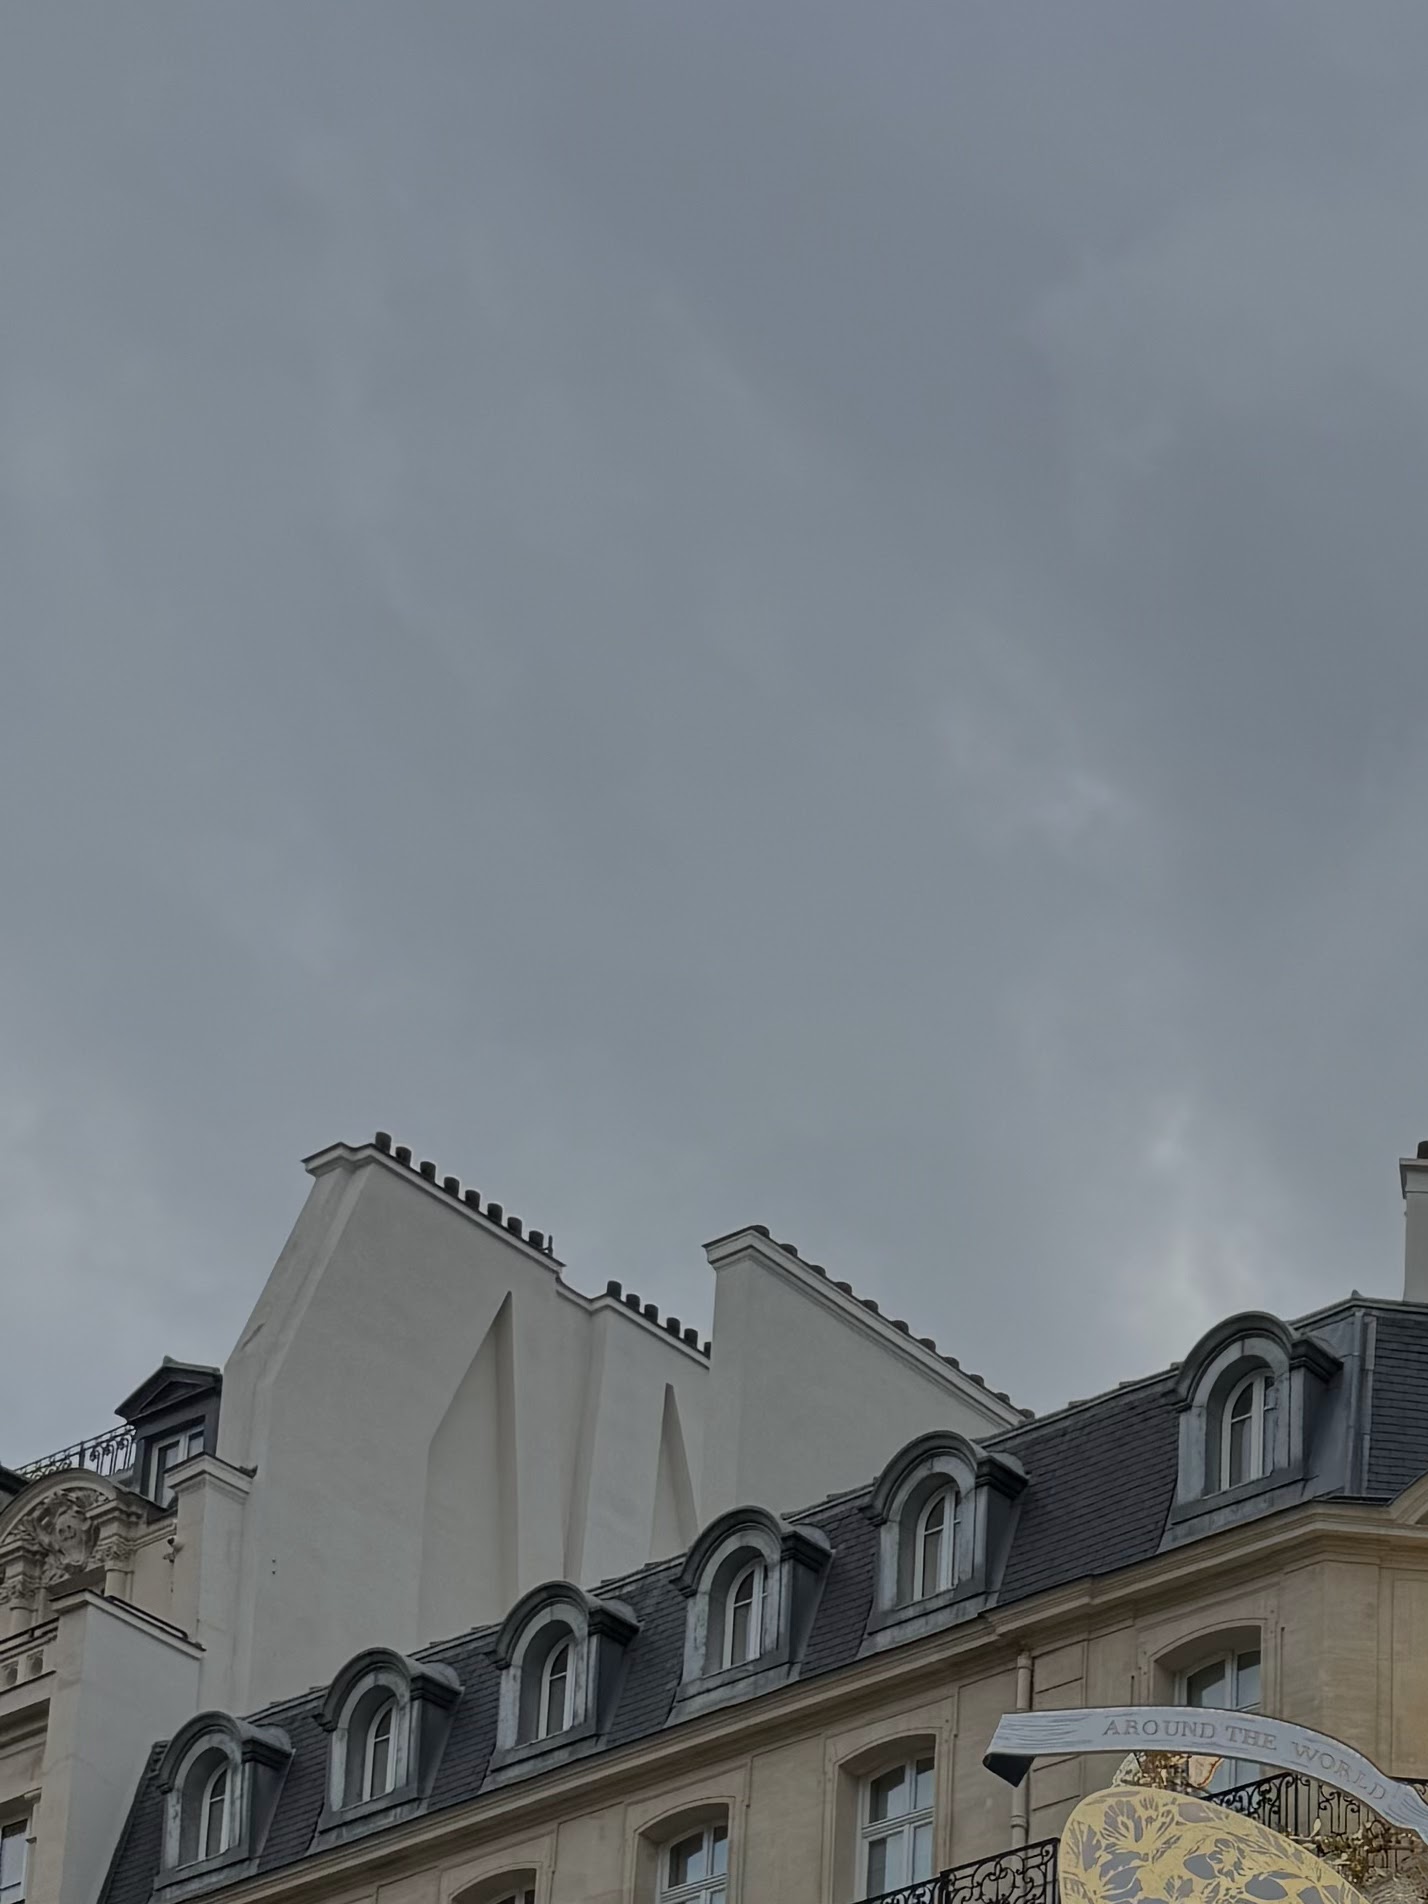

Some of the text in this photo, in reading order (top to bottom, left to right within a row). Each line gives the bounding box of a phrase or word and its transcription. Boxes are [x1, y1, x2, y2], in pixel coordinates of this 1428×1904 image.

[1102, 1718, 1388, 1801] AROUND THE WORLD
